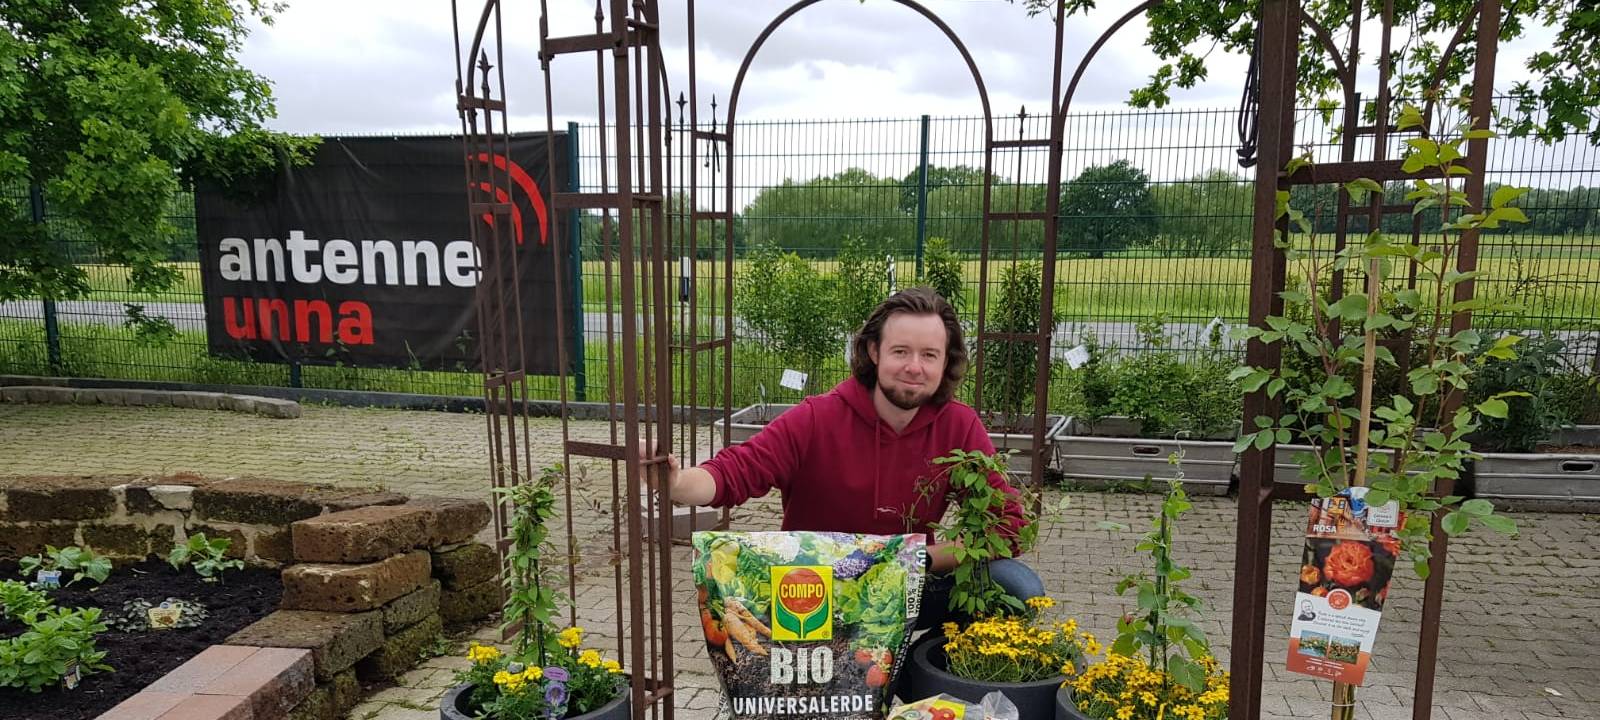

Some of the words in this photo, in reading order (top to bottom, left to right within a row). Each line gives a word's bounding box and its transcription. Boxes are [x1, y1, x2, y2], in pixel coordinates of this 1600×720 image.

[219, 230, 483, 288] antenne
[223, 296, 375, 345] unna
[1313, 524, 1337, 533] ROSA
[781, 583, 825, 599] COMPO
[770, 646, 834, 685] BIO
[733, 694, 874, 715] UNIVERSALERDE
